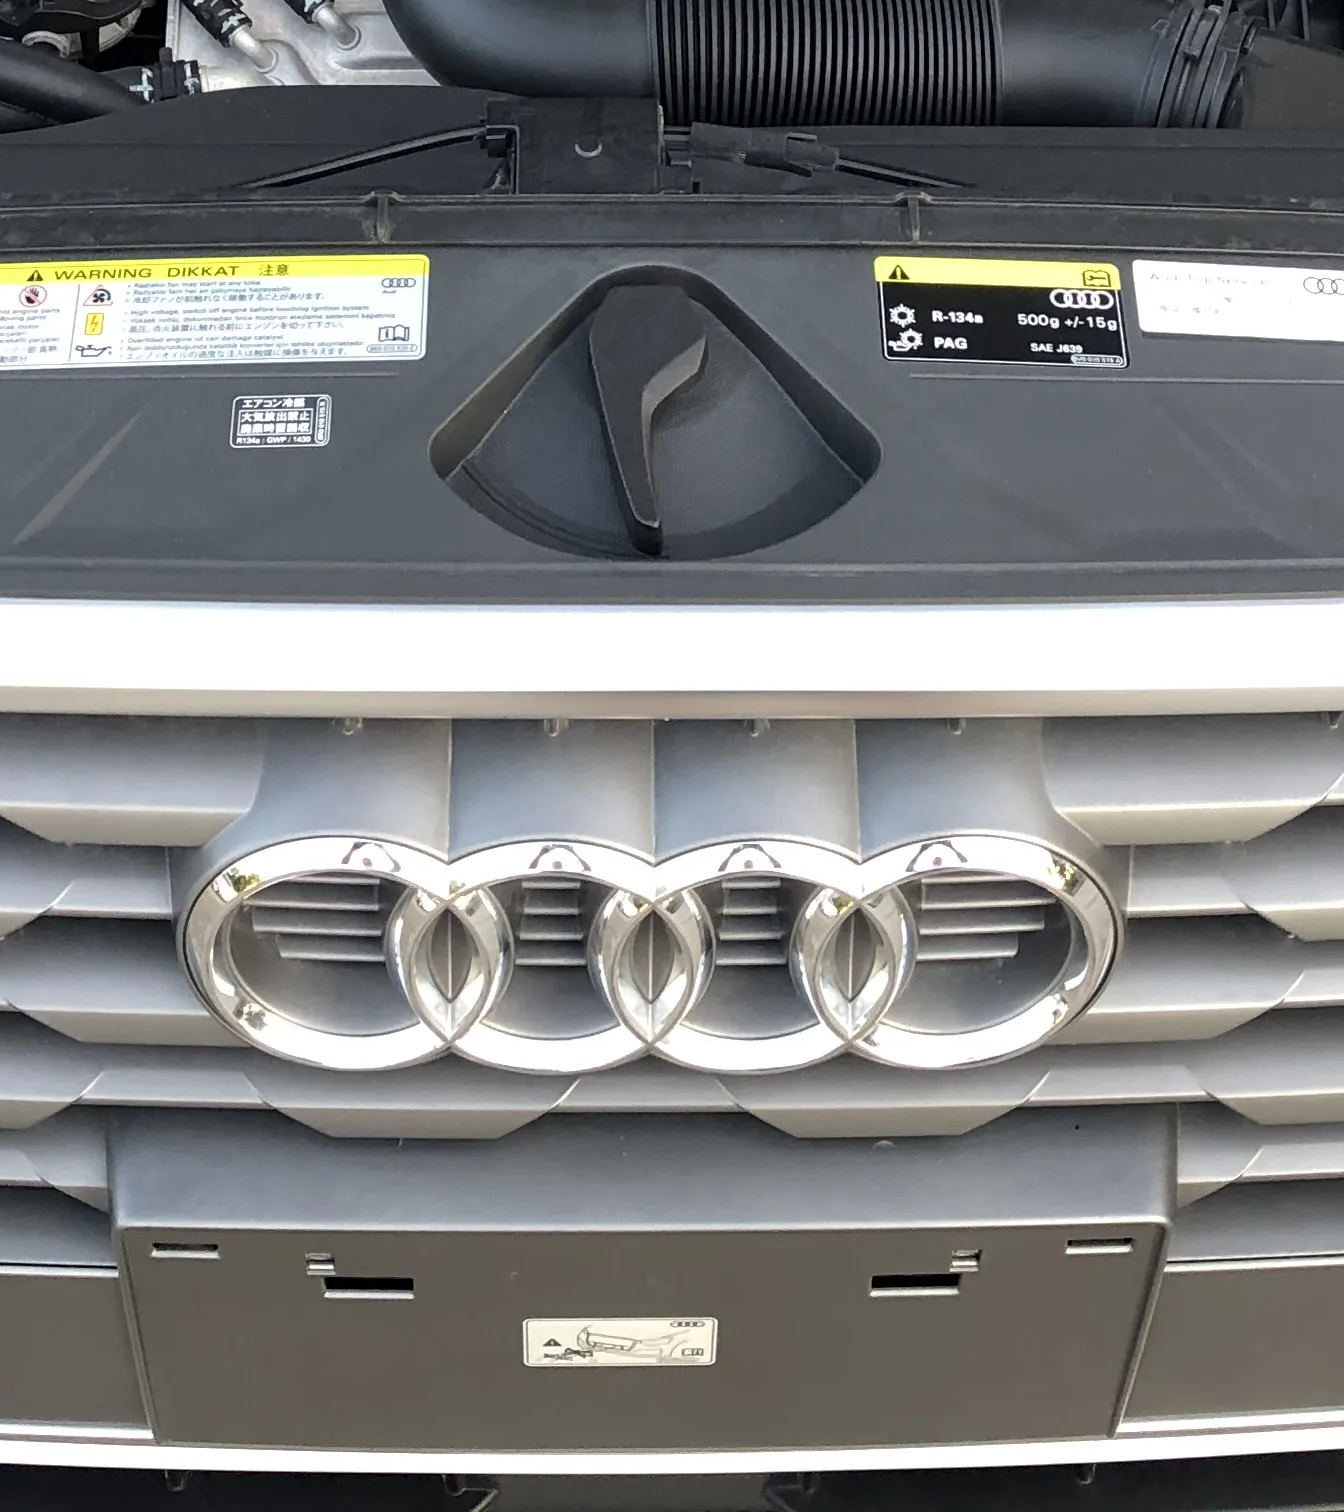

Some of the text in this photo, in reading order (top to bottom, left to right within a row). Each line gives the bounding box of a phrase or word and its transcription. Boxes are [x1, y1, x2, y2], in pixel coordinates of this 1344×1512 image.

[55, 265, 240, 280] WARNING DIKKAT
[258, 263, 289, 277] 注意
[932, 310, 983, 324] R-134a
[1017, 313, 1060, 329] 500g
[934, 336, 1084, 355] PAG SAE J639
[266, 435, 287, 444] GWP
